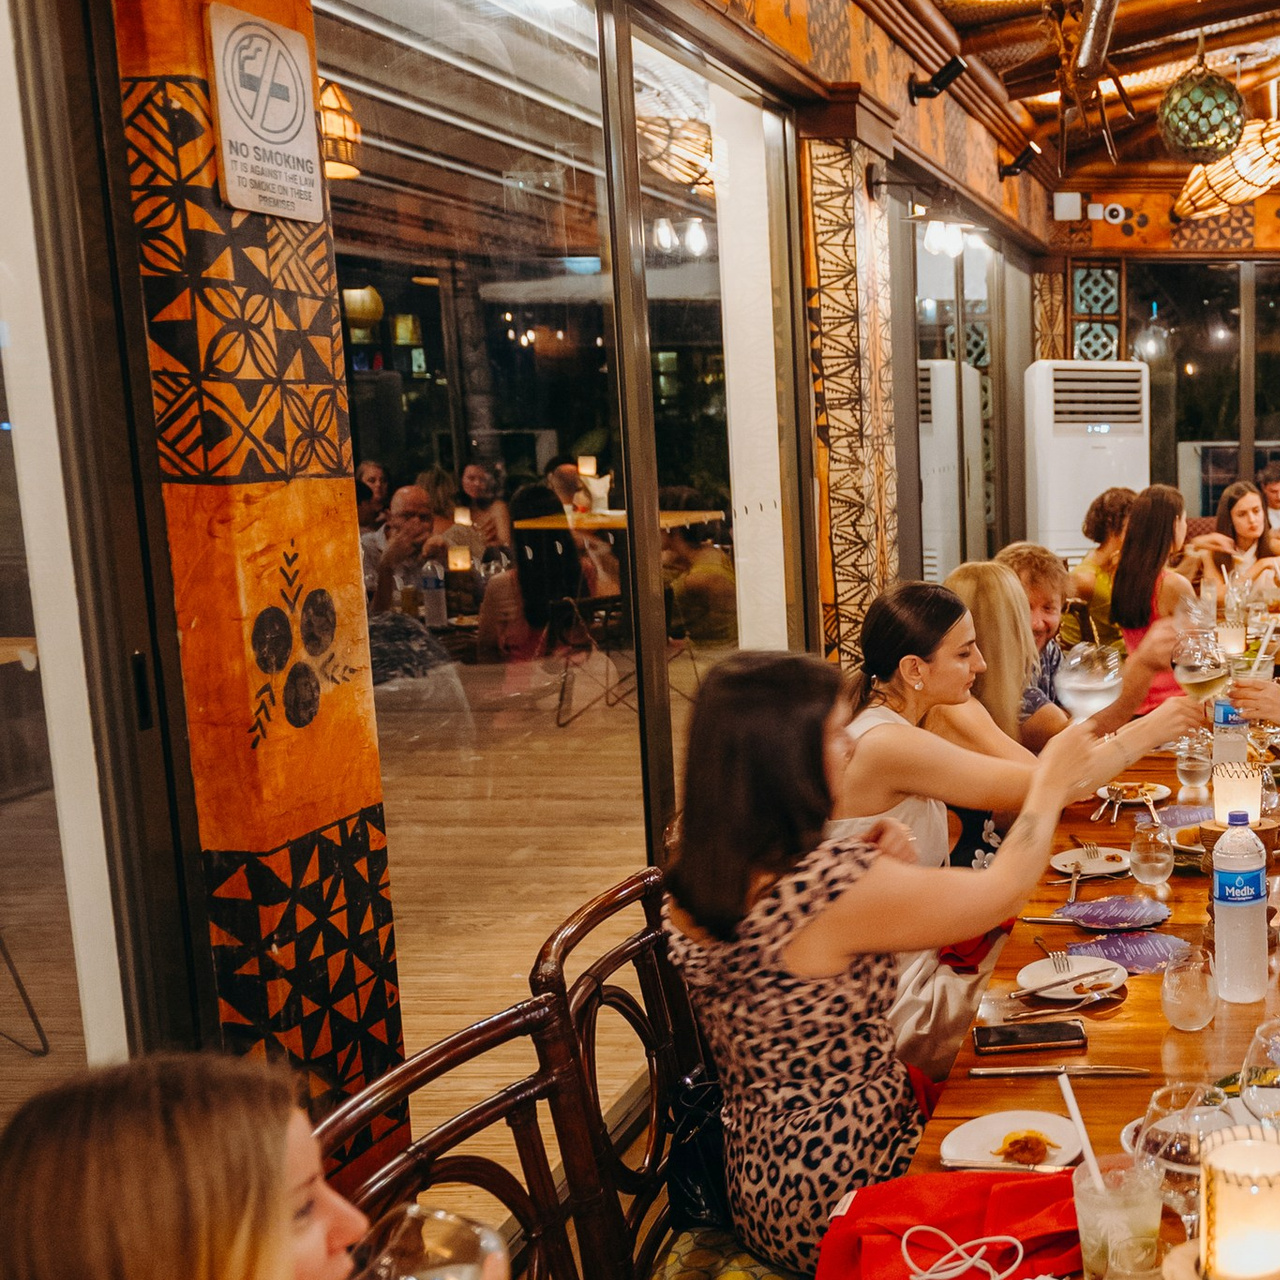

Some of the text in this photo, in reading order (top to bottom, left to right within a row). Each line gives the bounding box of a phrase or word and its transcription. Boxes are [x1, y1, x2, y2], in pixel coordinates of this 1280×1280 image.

[229, 140, 314, 174] NO SMOKING
[230, 160, 315, 188] IT IS AGAINST THE LAW
[237, 176, 313, 202] TO SMOKE ON THESE
[258, 194, 296, 211] PREMISES
